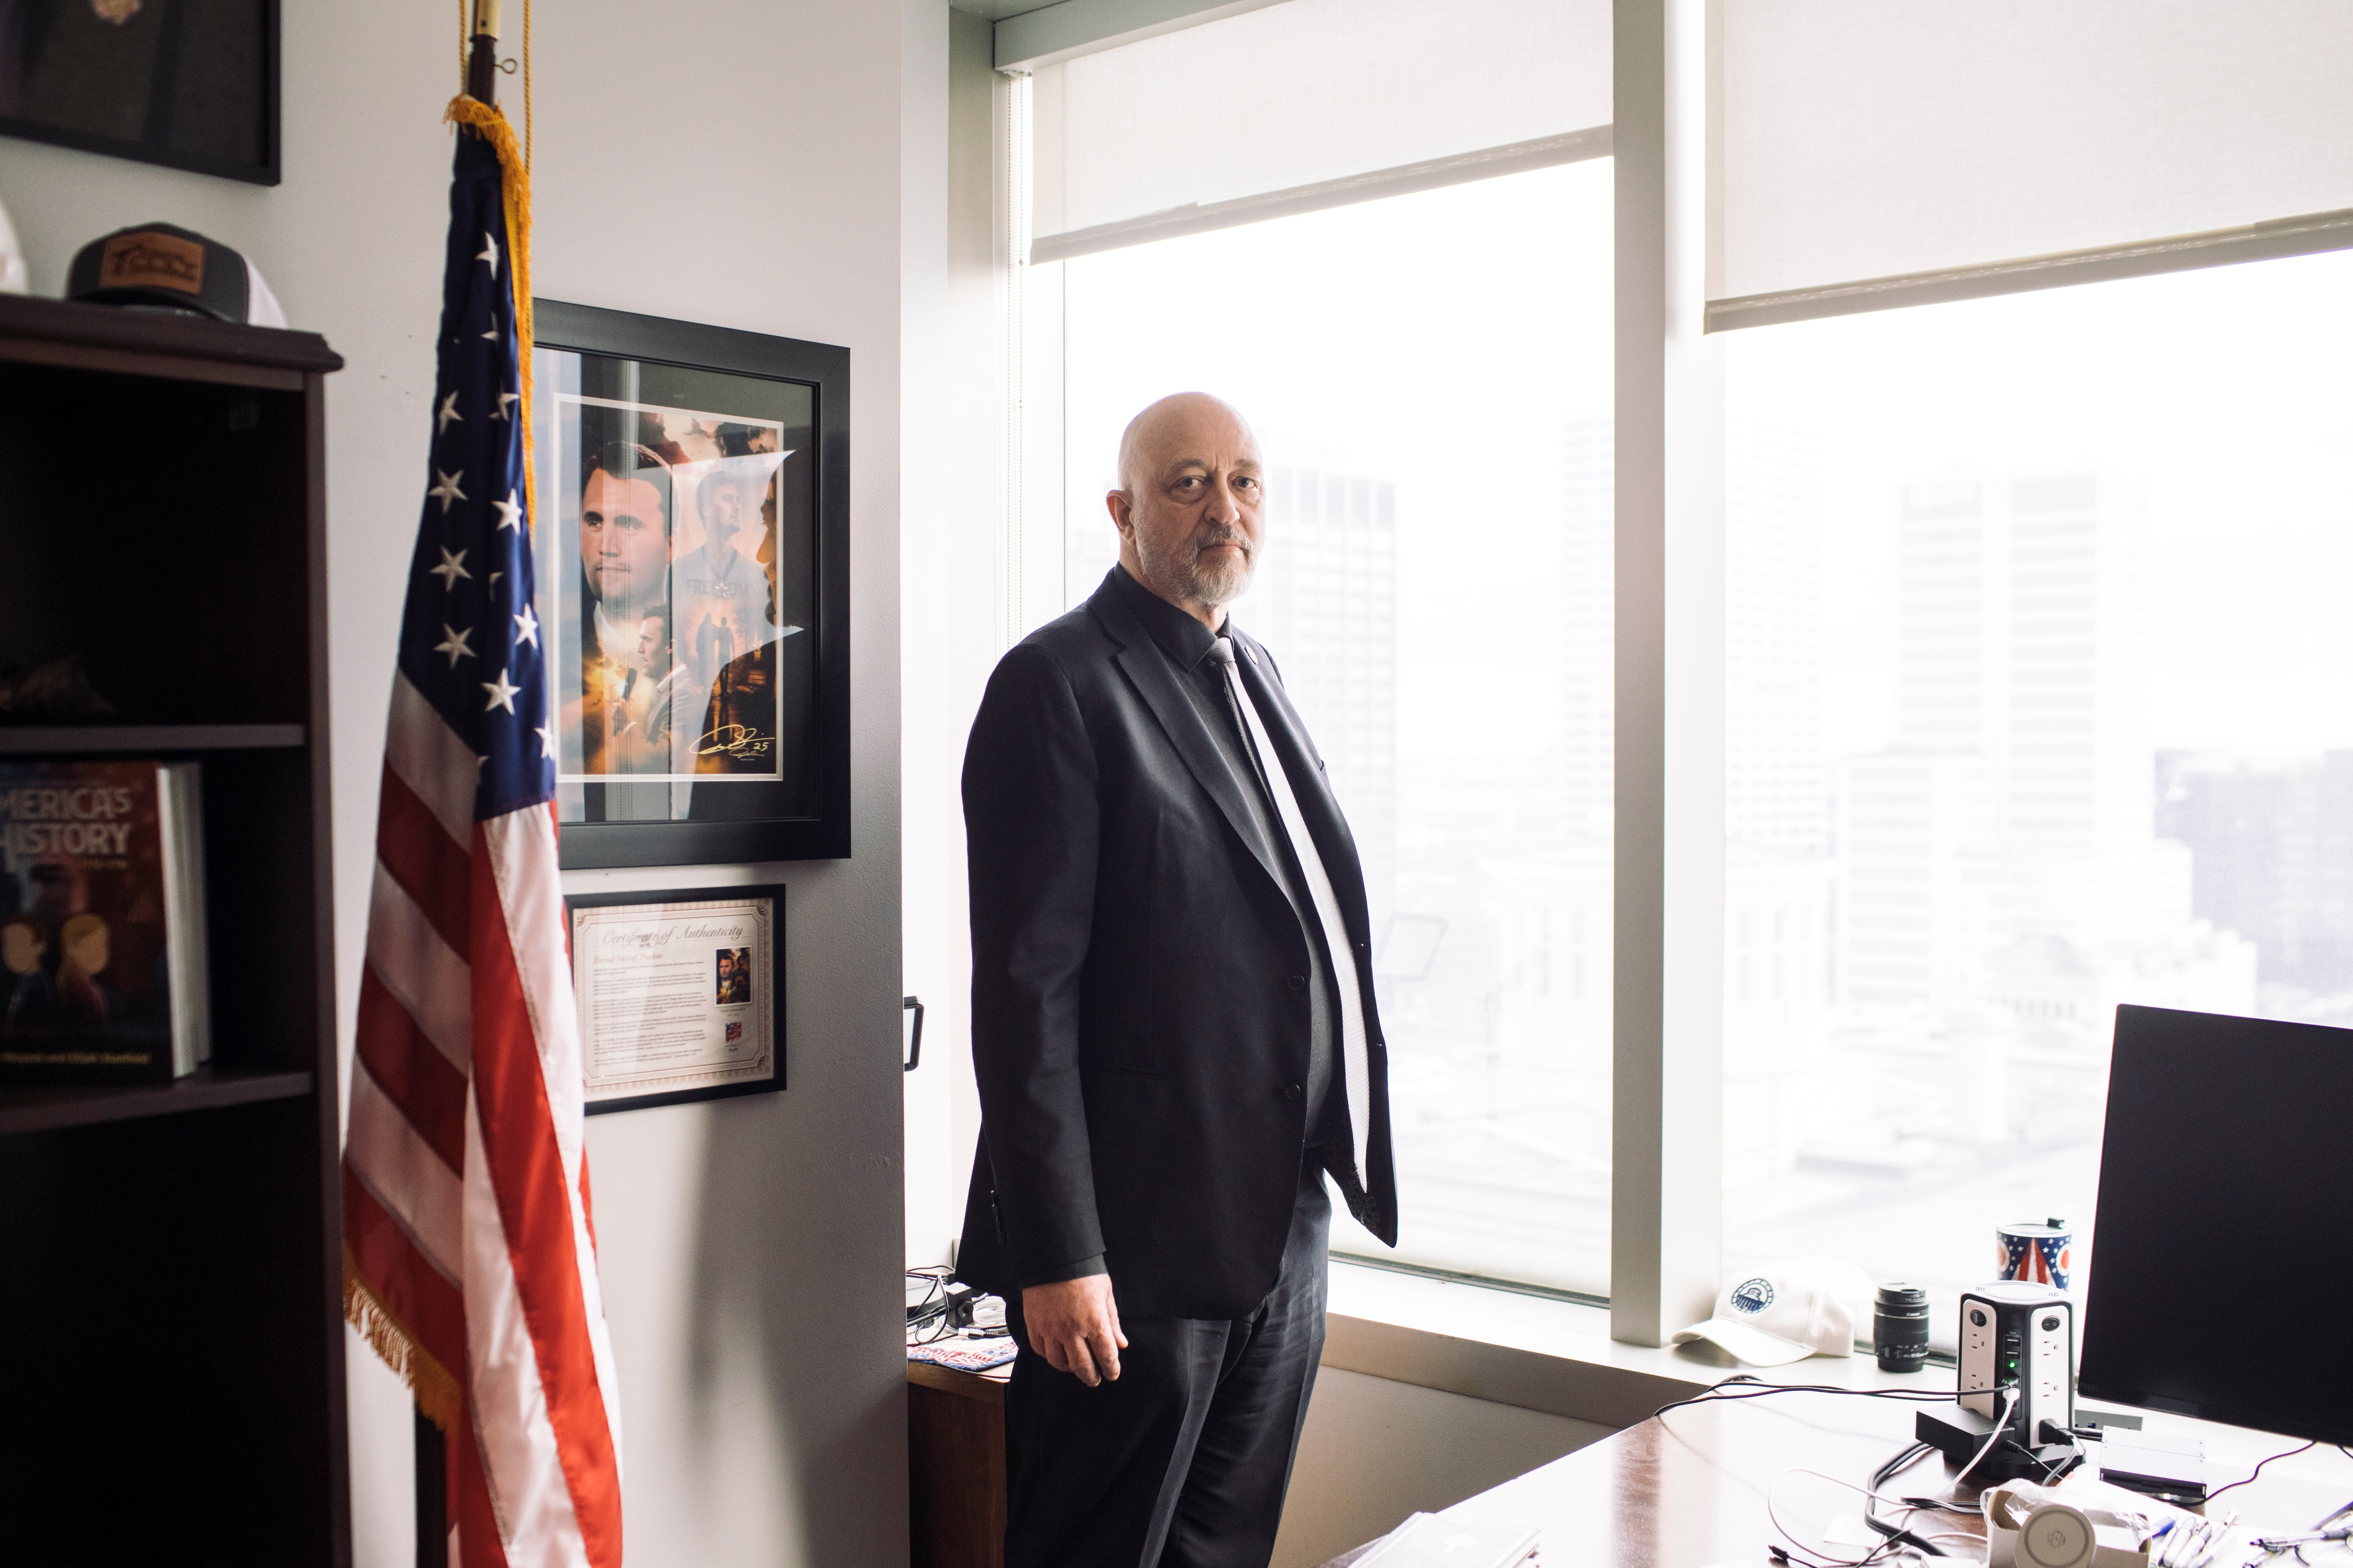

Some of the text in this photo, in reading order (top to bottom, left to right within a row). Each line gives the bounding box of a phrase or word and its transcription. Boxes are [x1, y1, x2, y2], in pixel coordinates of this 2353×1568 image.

[686, 579, 749, 597] FREEOM
[753, 742, 769, 751] 25
[659, 926, 678, 945] of
[676, 924, 744, 941] Authenticity
